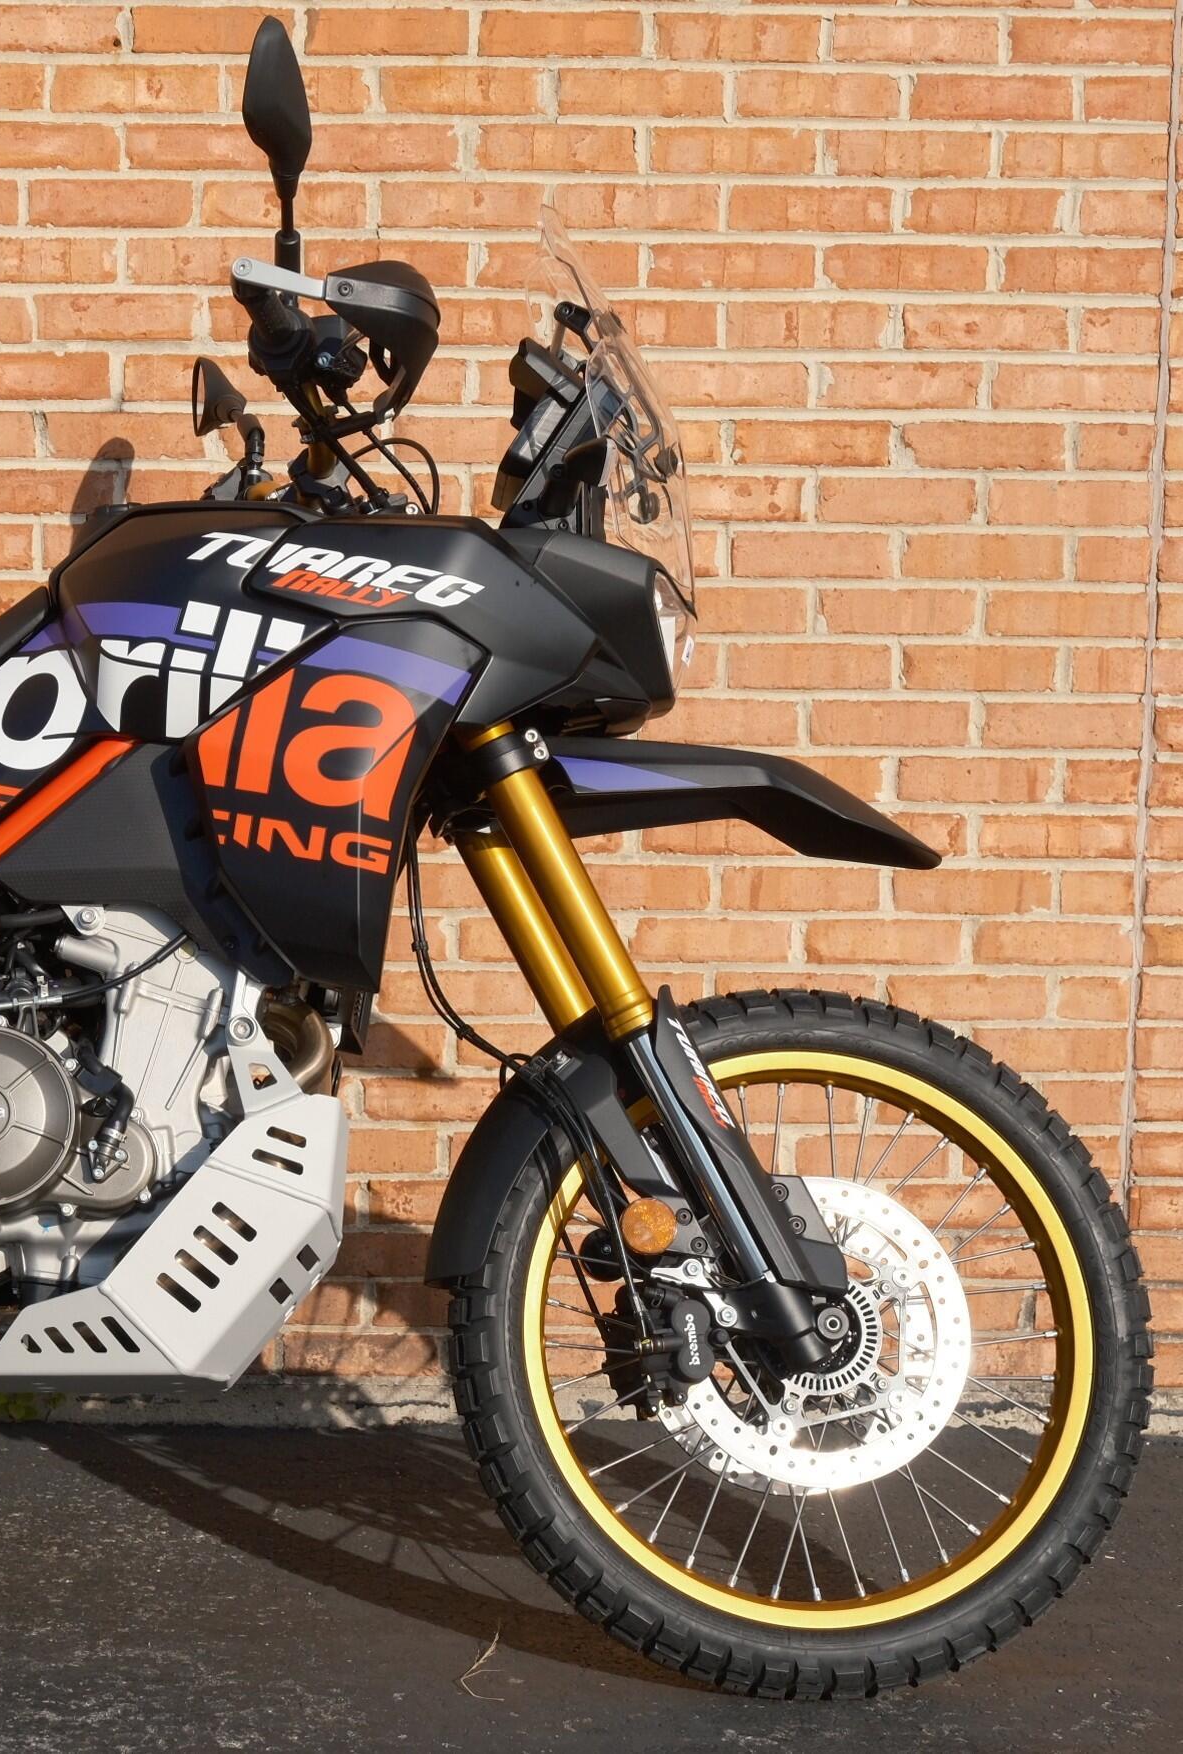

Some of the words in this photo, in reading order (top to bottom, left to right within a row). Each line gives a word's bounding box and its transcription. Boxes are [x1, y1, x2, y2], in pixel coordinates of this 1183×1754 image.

[186, 532, 485, 607] TUAREG
[272, 569, 408, 608] RALLY
[683, 1313, 700, 1366] brembo
